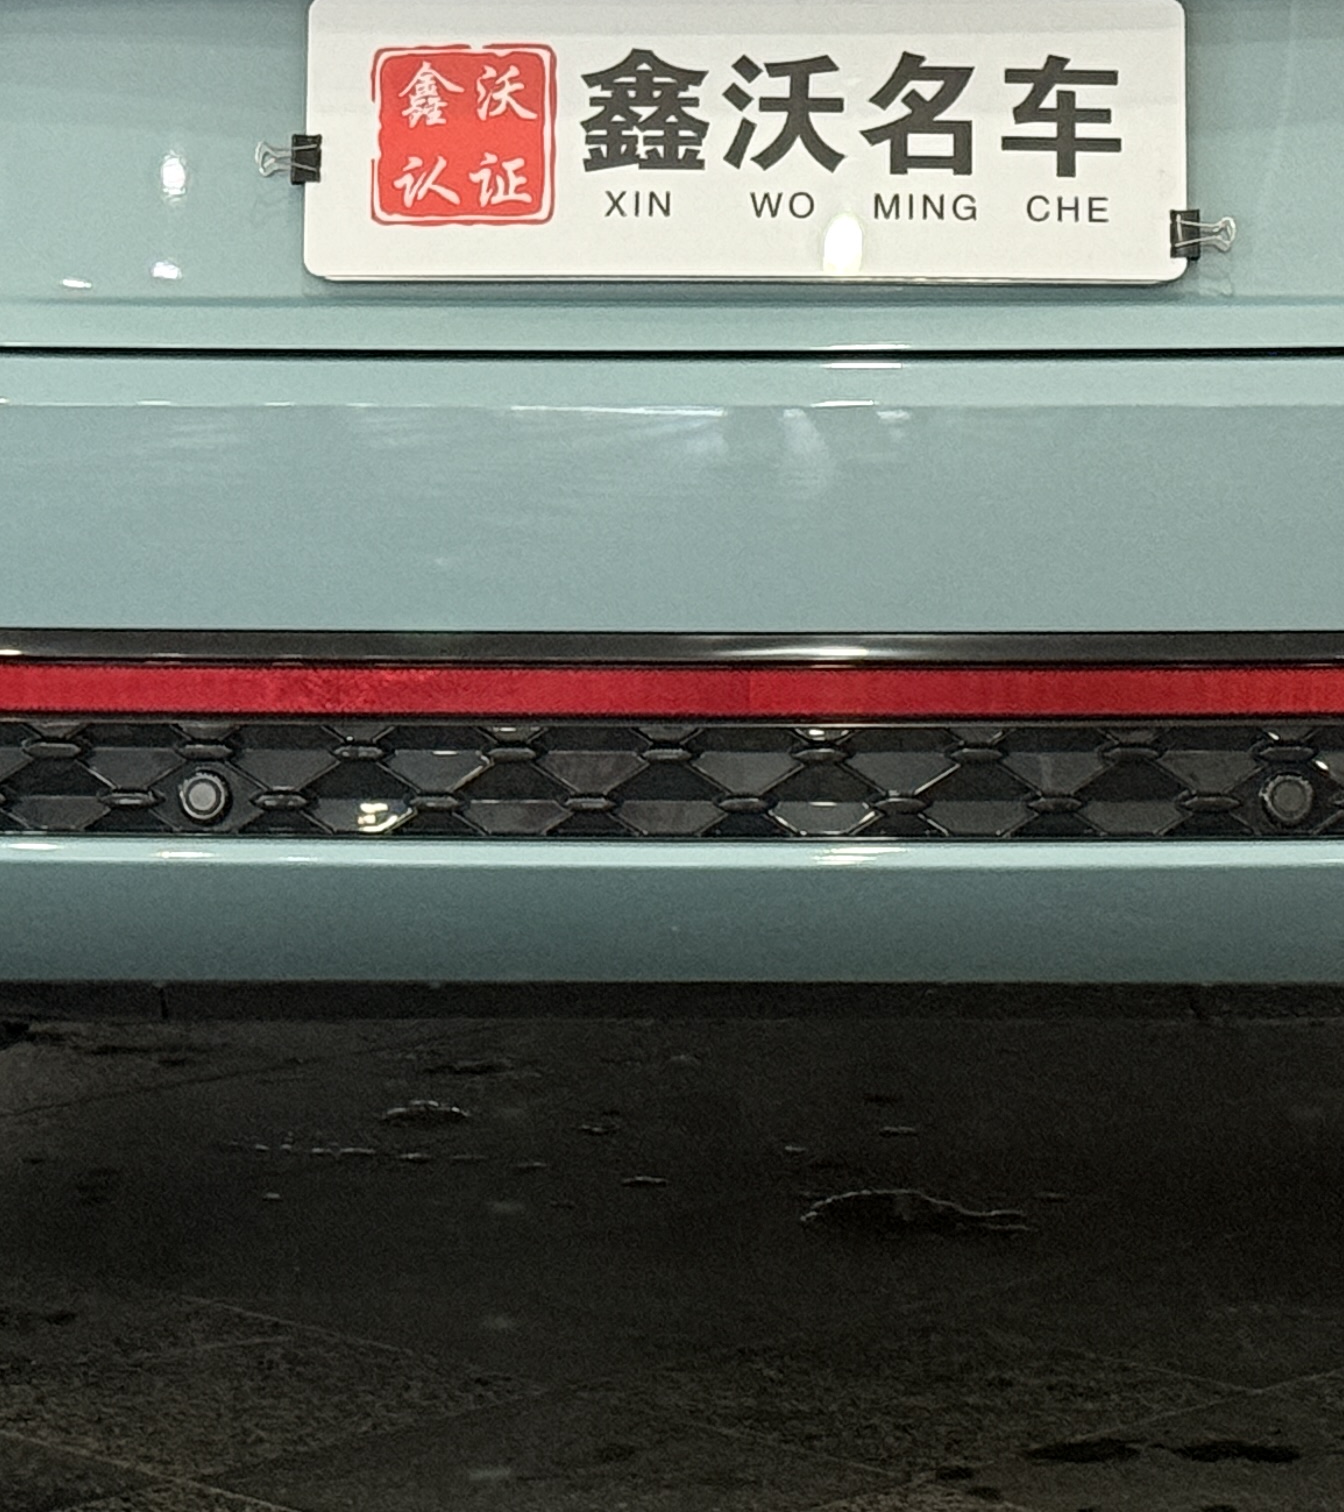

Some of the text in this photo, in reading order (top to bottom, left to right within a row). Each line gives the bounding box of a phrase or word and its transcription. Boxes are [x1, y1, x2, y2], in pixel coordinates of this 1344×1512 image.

[398, 60, 538, 129] 鑫沃
[580, 47, 1123, 178] 鑫沃名车
[393, 152, 533, 208] 认证
[605, 191, 1110, 224] XIN WO MING CHE
